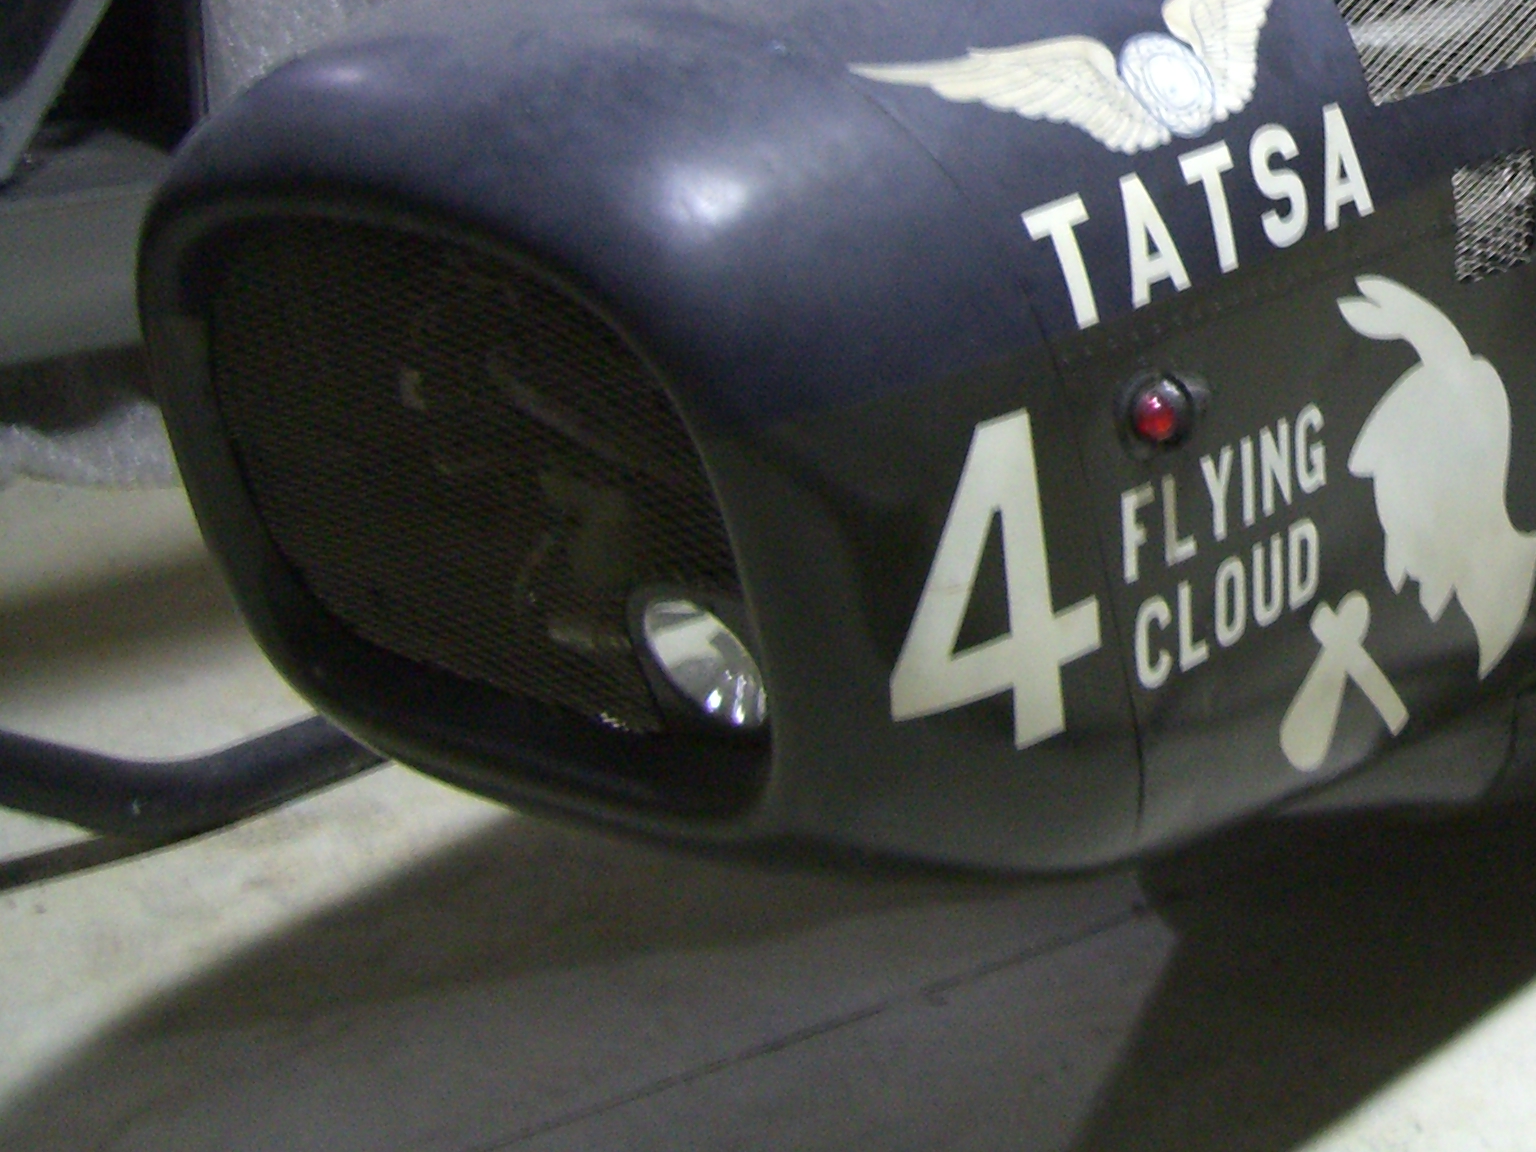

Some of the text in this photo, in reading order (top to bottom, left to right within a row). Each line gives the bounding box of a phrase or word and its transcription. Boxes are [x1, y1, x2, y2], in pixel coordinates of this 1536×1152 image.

[1022, 102, 1375, 329] TATSA
[889, 408, 1101, 750] 4
[1120, 402, 1327, 584] FLYING
[1134, 518, 1320, 689] CLOUD
